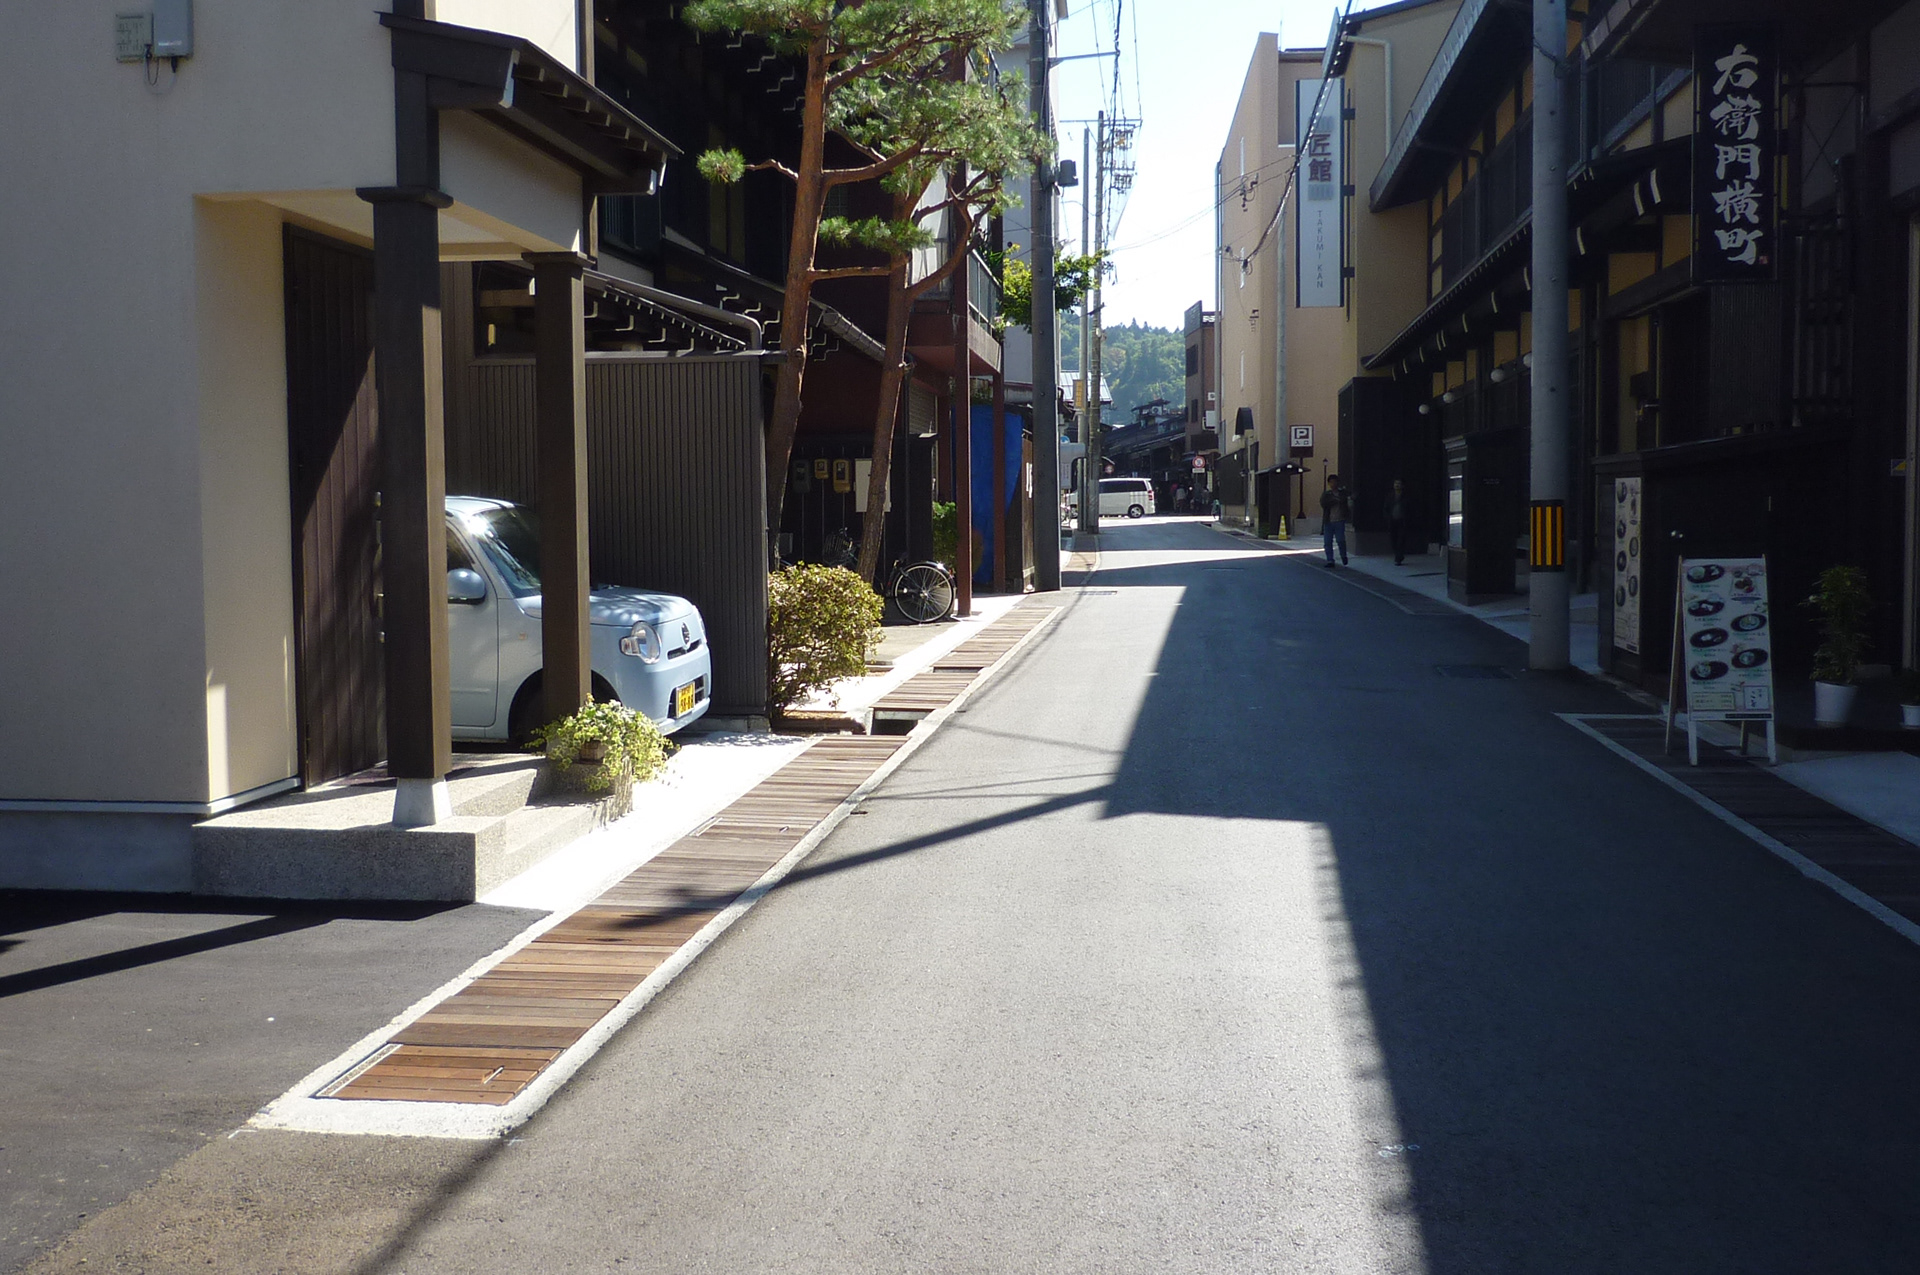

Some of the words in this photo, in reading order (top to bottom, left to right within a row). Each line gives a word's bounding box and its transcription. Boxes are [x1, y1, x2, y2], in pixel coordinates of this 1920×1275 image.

[1308, 133, 1332, 182] 匠館
[1316, 210, 1324, 259] TAKUMI
[1296, 429, 1307, 439] P
